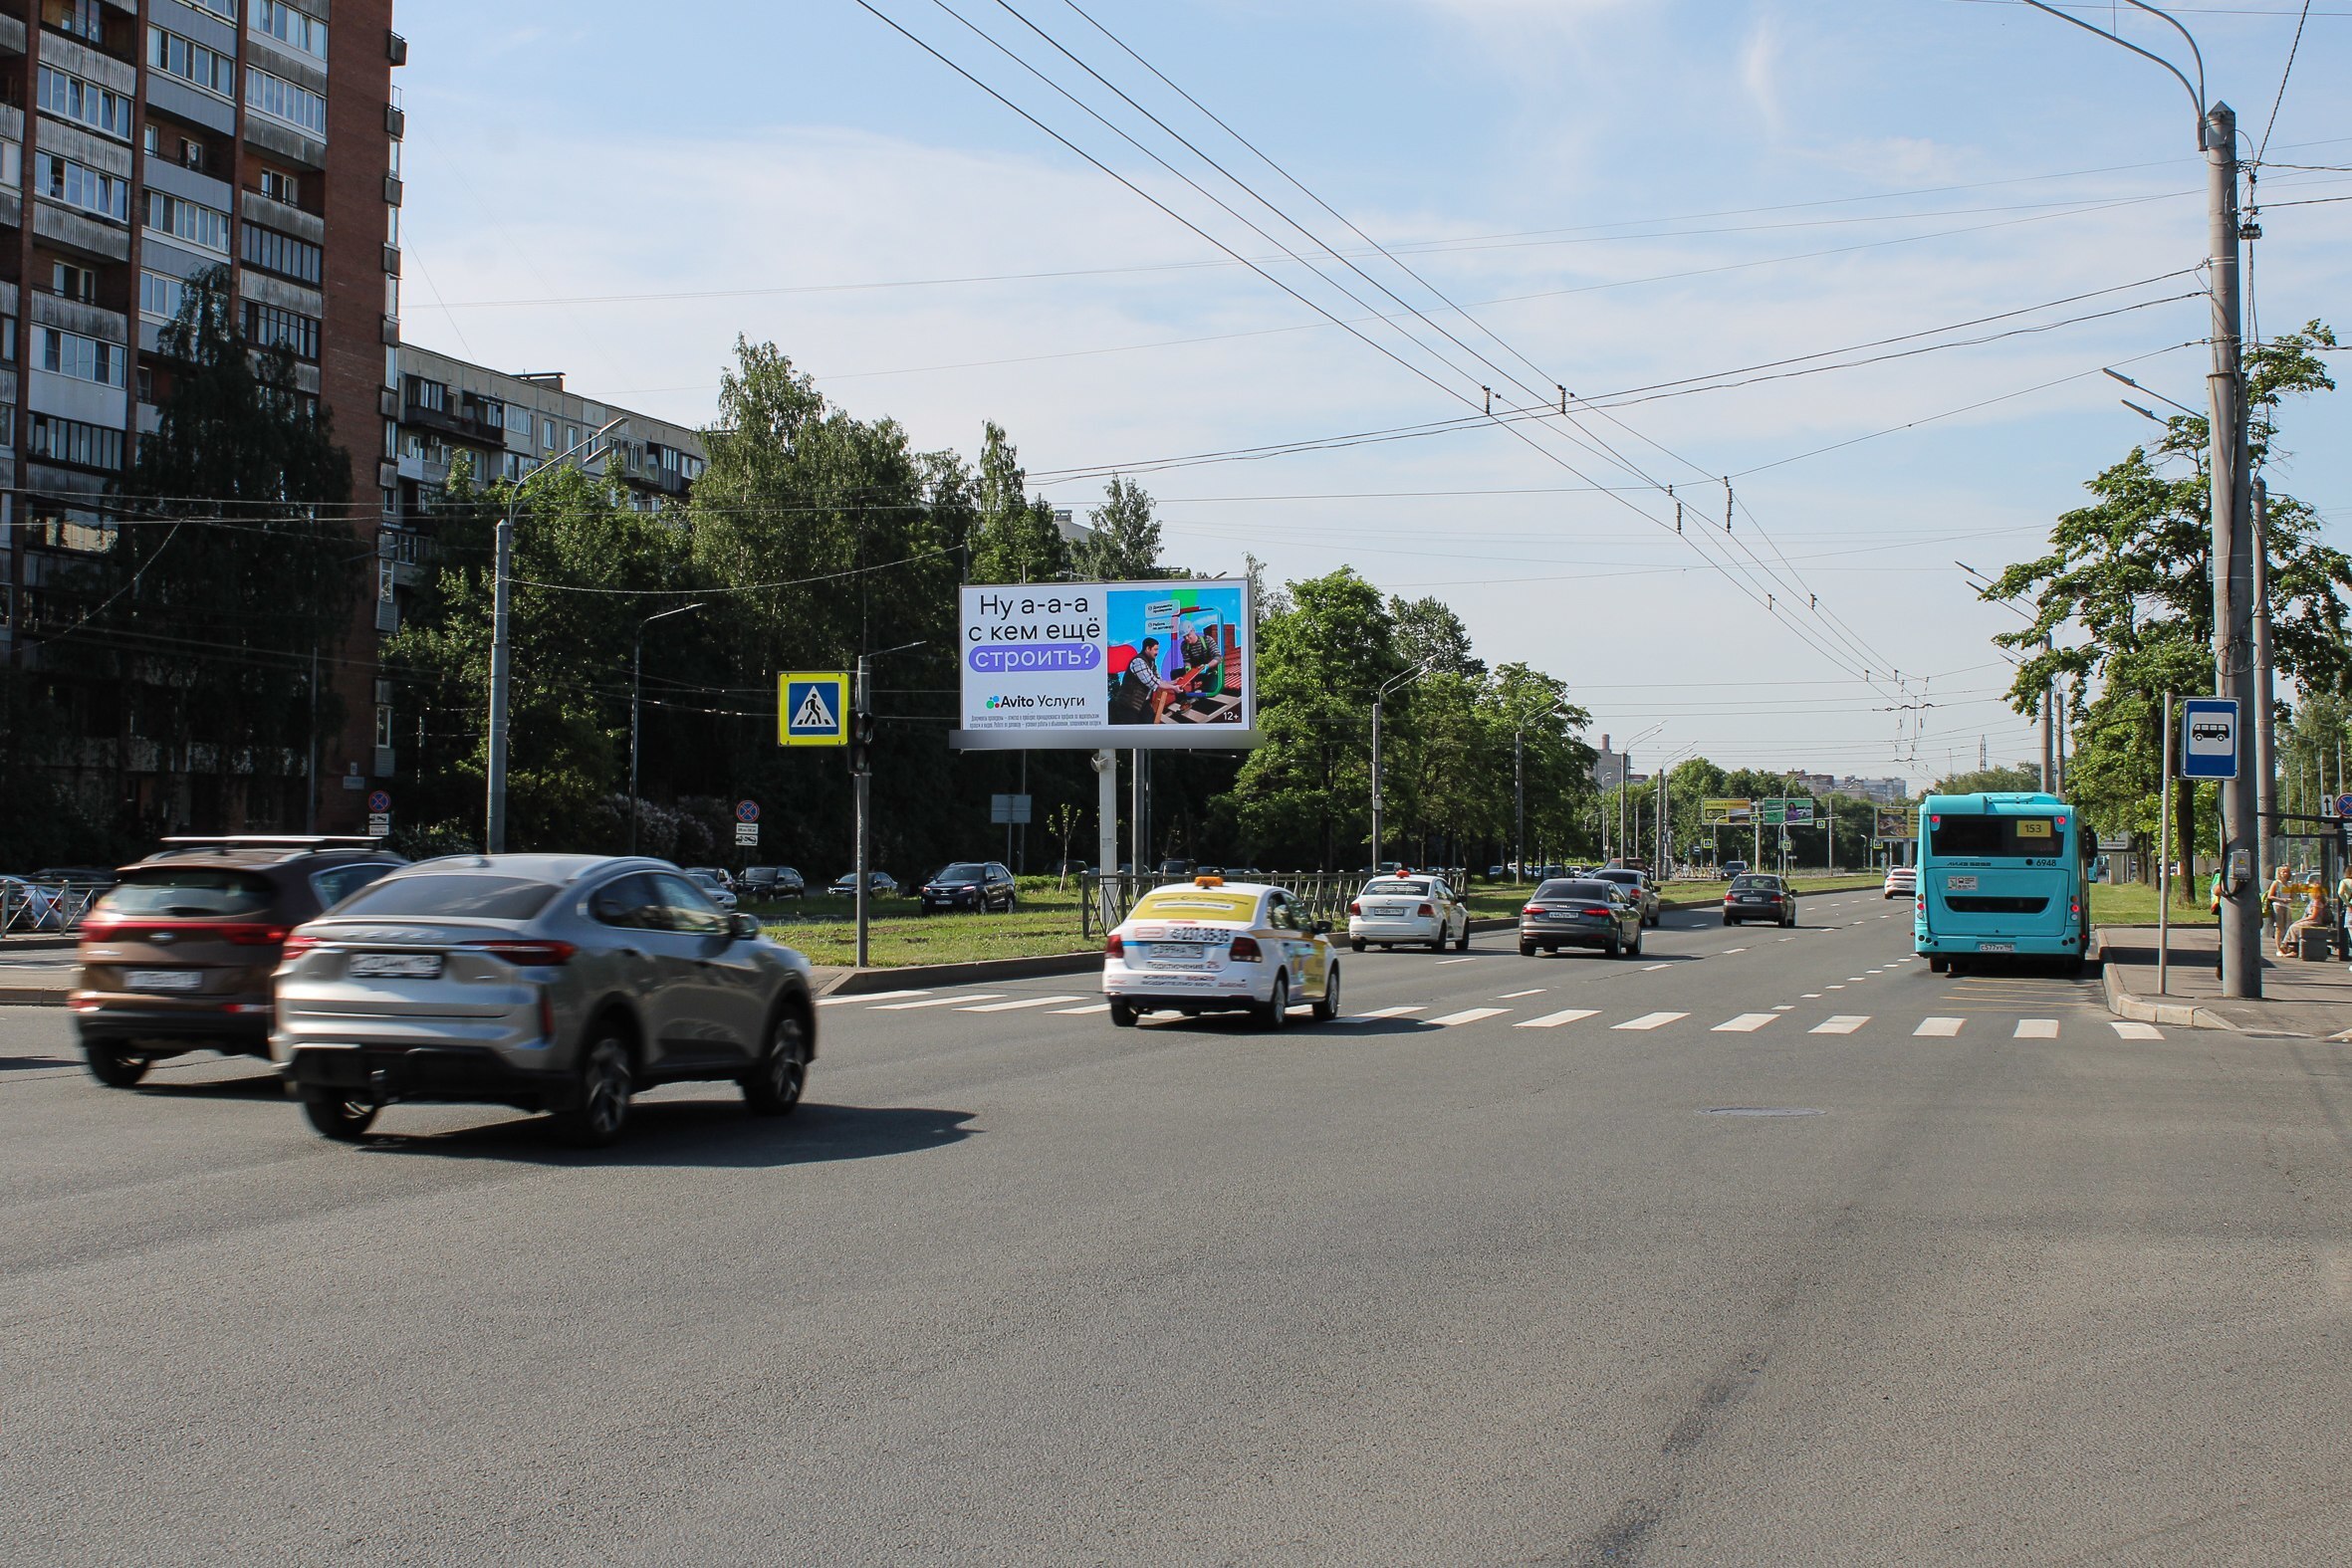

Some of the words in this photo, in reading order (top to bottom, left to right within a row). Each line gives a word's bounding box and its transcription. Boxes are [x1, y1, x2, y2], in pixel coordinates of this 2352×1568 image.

[981, 594, 1014, 620] Ну
[1021, 597, 1088, 614] а-а-а
[969, 626, 982, 642] с
[991, 625, 1038, 640] кем
[1047, 617, 1100, 641] ещё
[975, 643, 1094, 672] строить?
[1001, 695, 1035, 708] Avito
[1037, 695, 1085, 709] Услуги
[1223, 712, 1240, 721] 12+
[2024, 823, 2041, 833] 153
